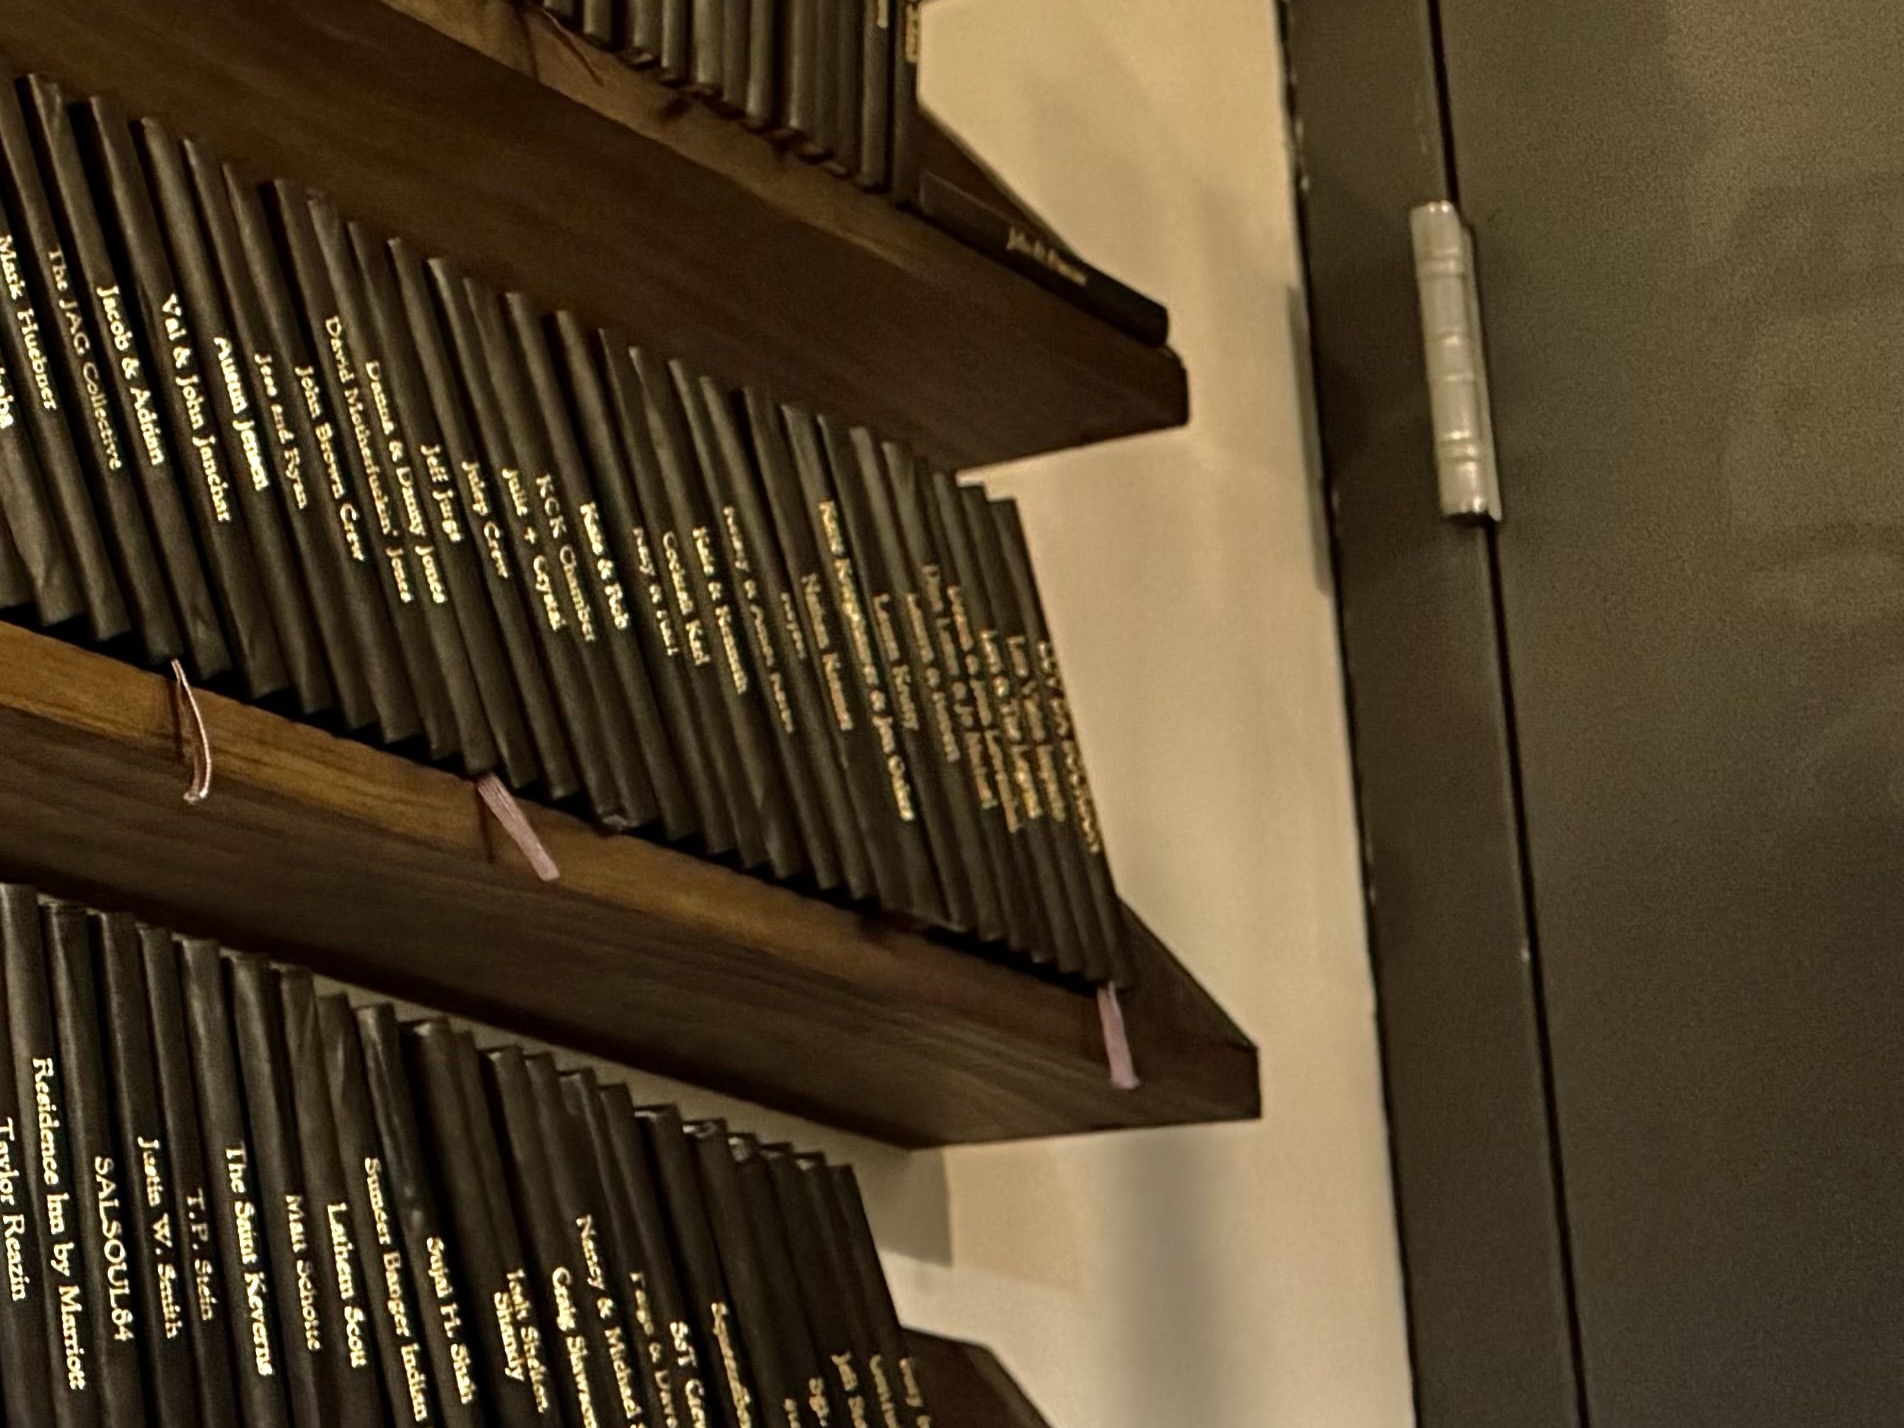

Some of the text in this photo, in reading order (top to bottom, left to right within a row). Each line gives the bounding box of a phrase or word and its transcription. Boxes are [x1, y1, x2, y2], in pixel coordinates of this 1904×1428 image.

[95, 284, 164, 466] Jacob & Adrian
[31, 1056, 60, 1185] Residence
[49, 1241, 75, 1277] by
[596, 1296, 614, 1319] &
[57, 1284, 86, 1390] Marriott
